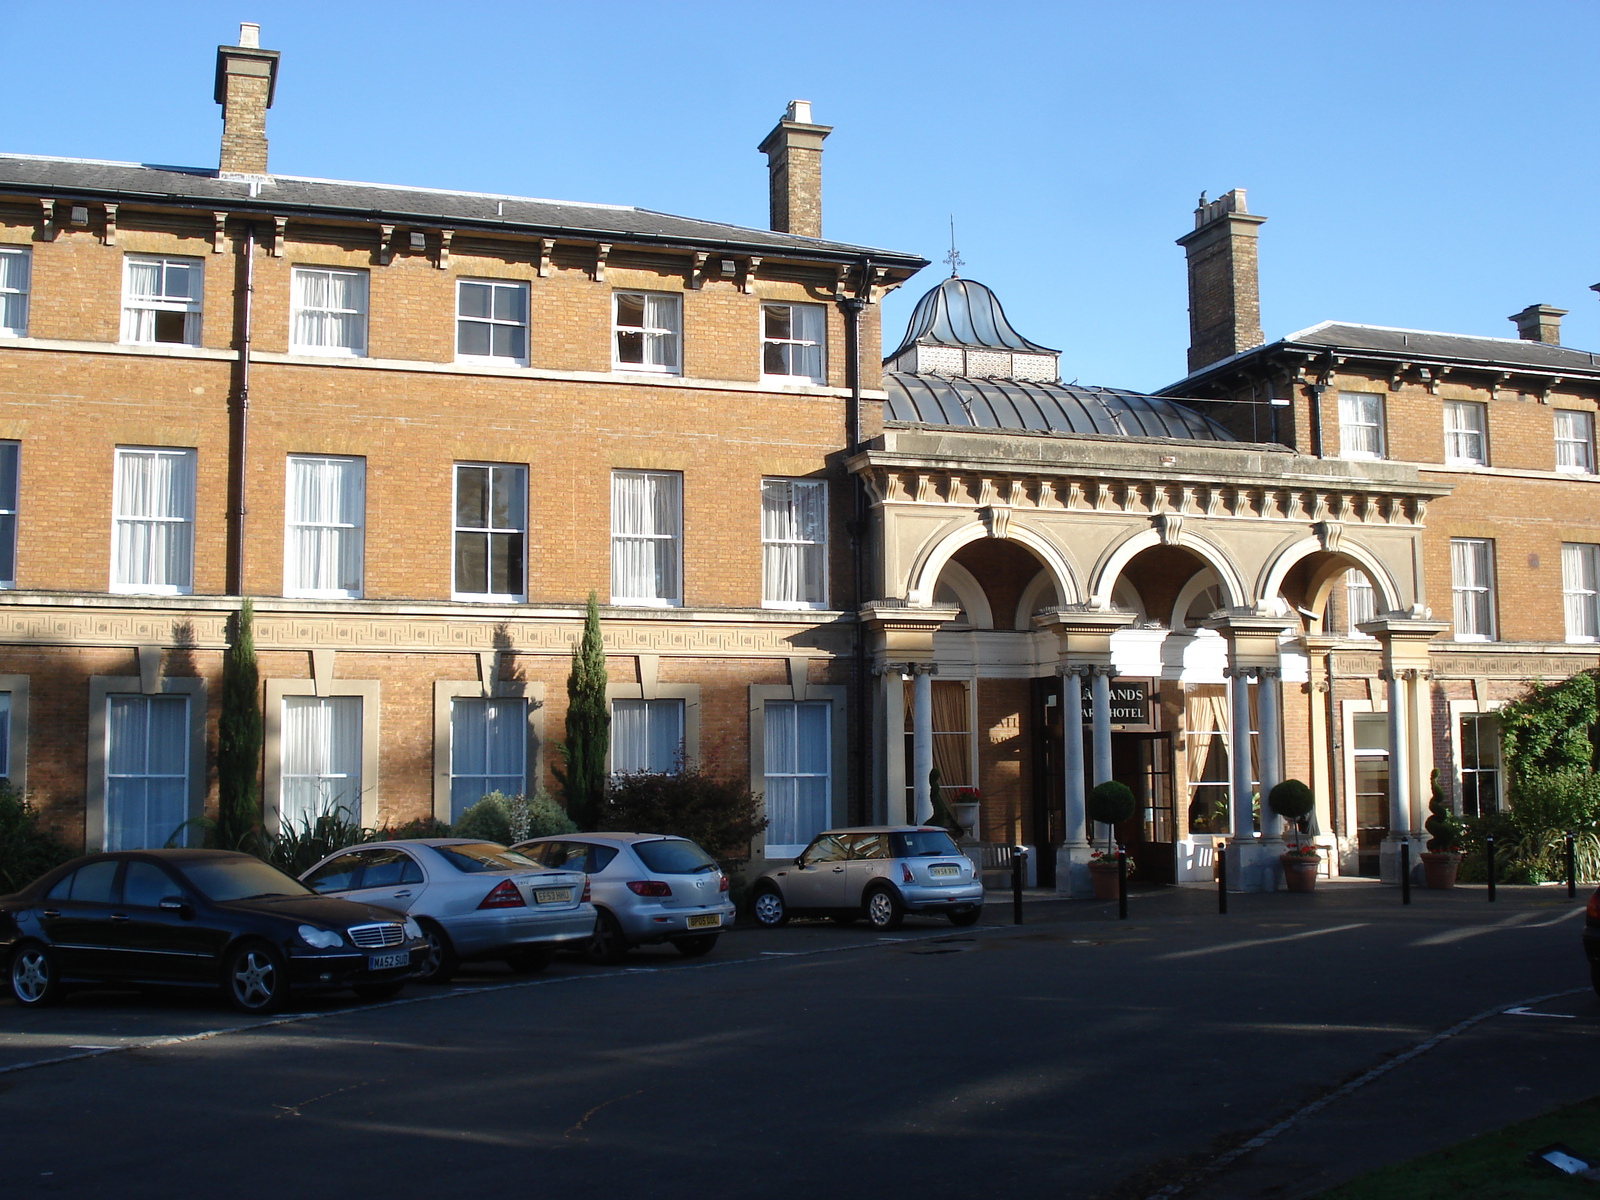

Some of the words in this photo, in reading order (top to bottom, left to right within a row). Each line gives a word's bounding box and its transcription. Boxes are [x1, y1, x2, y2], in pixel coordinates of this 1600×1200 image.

[1109, 708, 1144, 718] HOTEL
[538, 891, 556, 901] EF53
[374, 956, 394, 968] MA52
